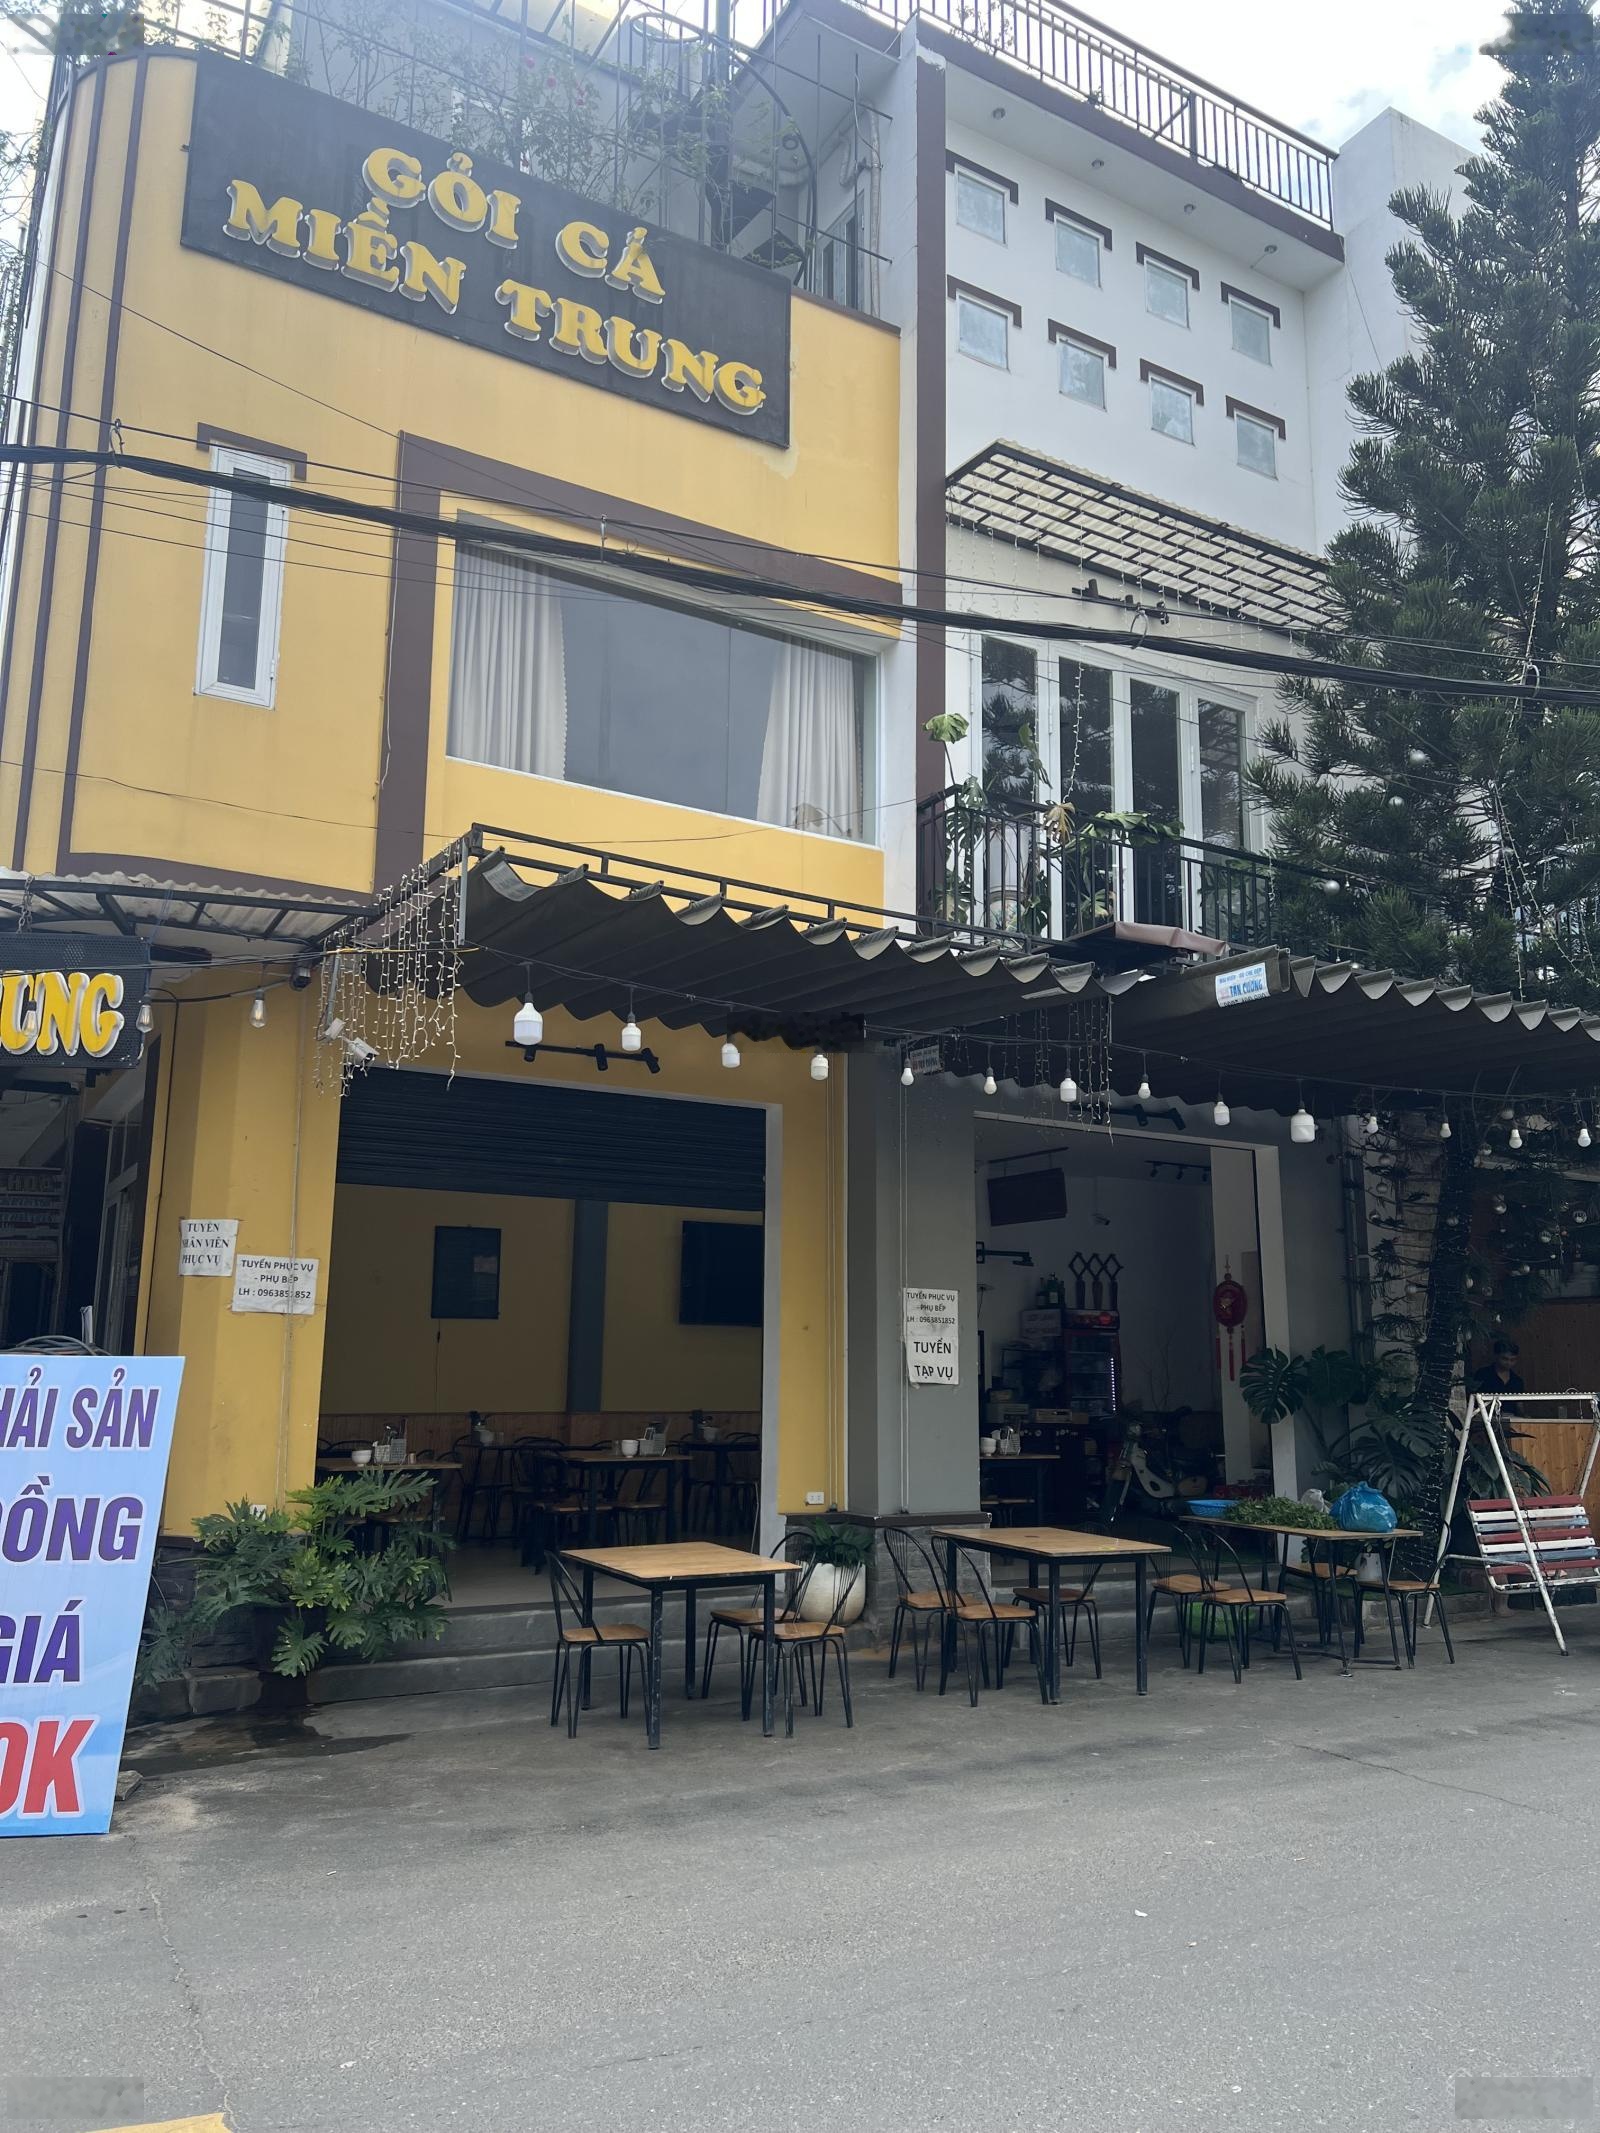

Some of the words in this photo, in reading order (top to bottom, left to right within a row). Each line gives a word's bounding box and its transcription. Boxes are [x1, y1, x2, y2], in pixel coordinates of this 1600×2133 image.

[362, 147, 522, 249] GỎI
[223, 180, 466, 314] MIỀN
[495, 279, 767, 416] TRUNG
[0, 971, 125, 1057] UNG
[204, 1236, 230, 1248] VIÊN
[206, 1254, 221, 1266] VỤ
[260, 1274, 280, 1284] PHỤ
[274, 1262, 298, 1271] PHỤC
[301, 1264, 314, 1272] VỤ
[914, 1365, 934, 1380] TẠP
[936, 1366, 954, 1381] VỤ
[66, 1367, 160, 1449] SẢN
[0, 1476, 144, 1562] ỒNG
